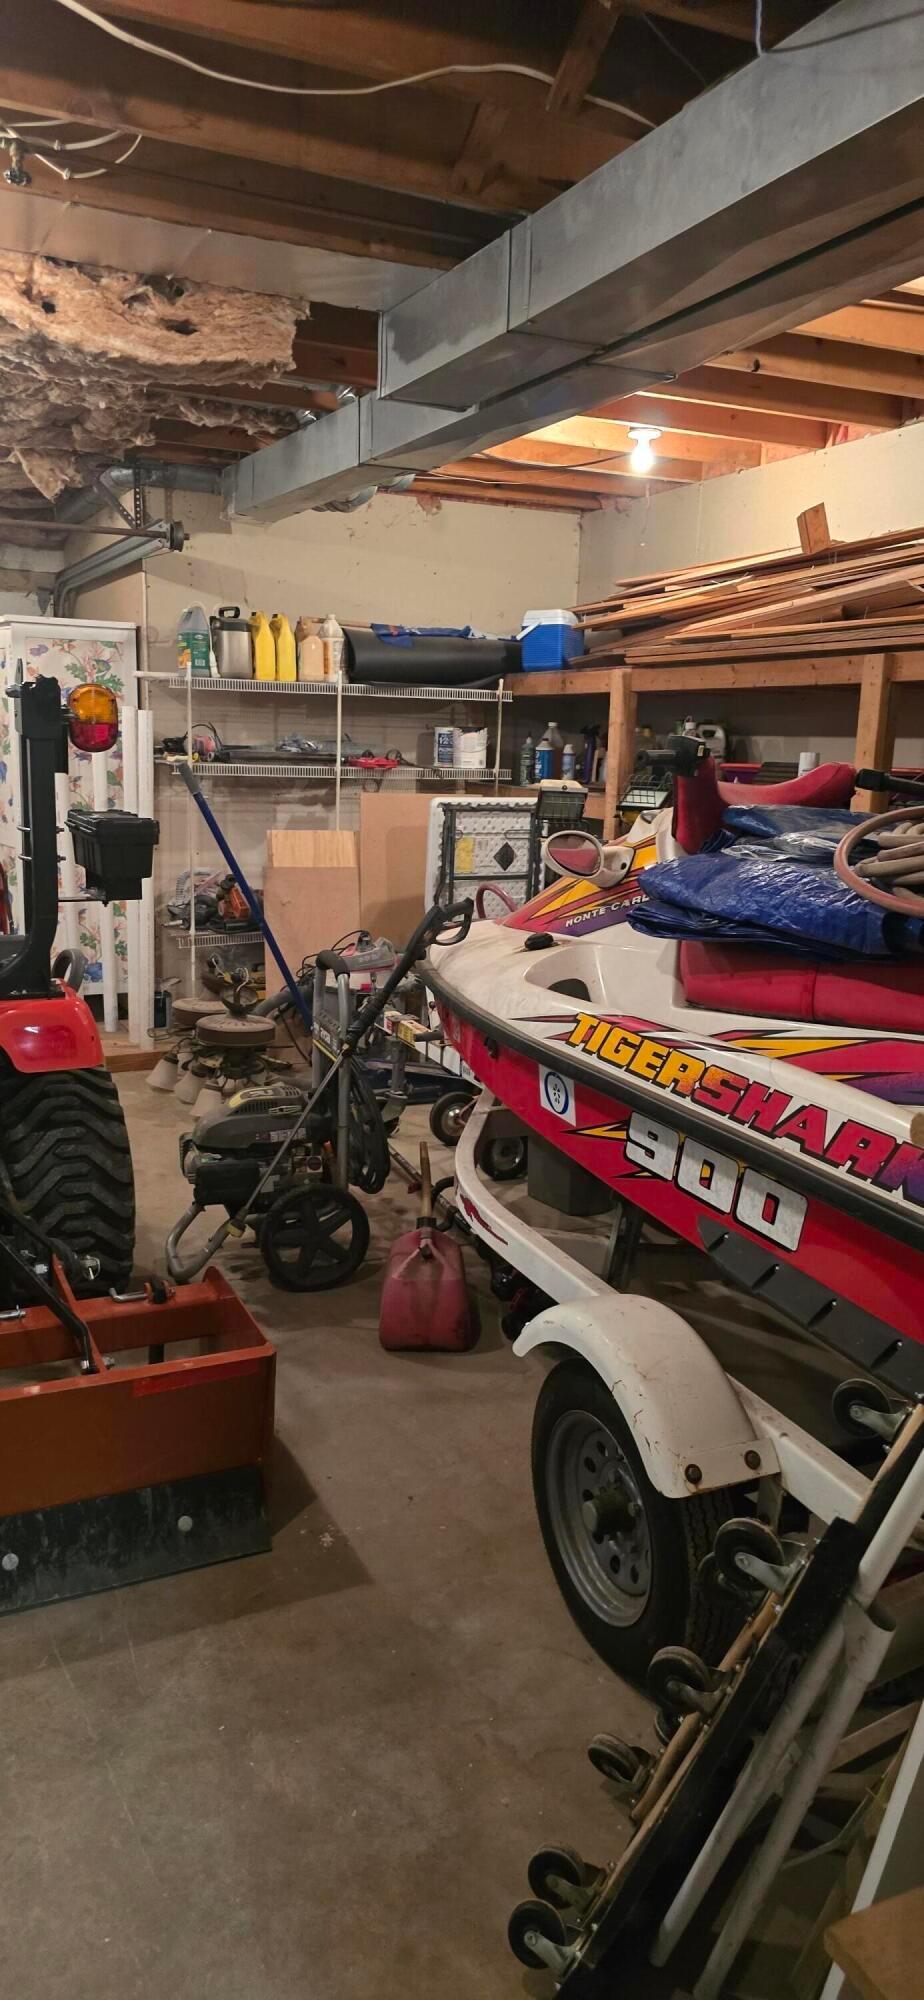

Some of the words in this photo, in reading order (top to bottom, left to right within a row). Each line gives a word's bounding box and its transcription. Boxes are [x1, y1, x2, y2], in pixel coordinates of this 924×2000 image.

[565, 908, 606, 927] MONTE
[611, 894, 650, 911] CARL
[623, 1110, 808, 1252] 900
